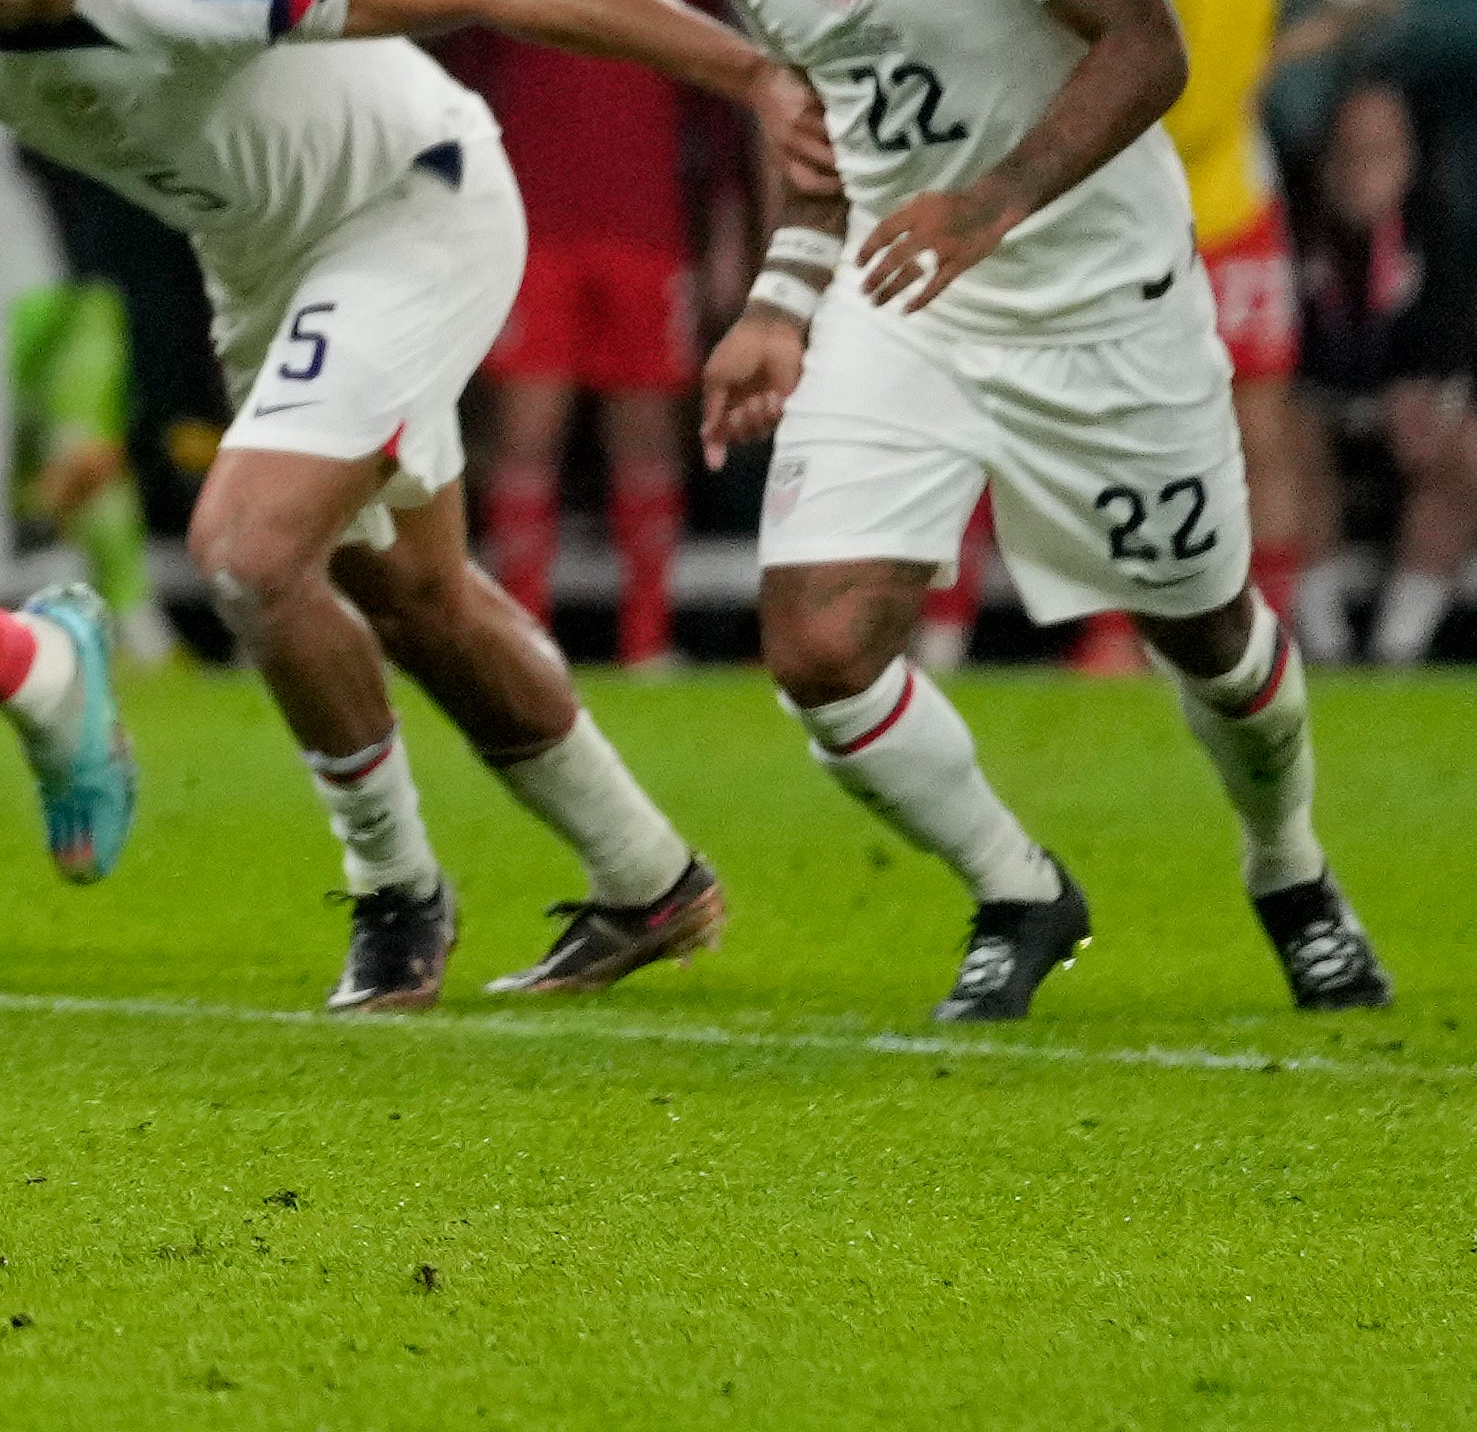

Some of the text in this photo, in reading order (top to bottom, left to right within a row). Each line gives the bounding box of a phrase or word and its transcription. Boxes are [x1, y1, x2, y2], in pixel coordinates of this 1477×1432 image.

[850, 61, 969, 153] 22
[278, 301, 337, 381] 5
[1094, 476, 1219, 561] 22
